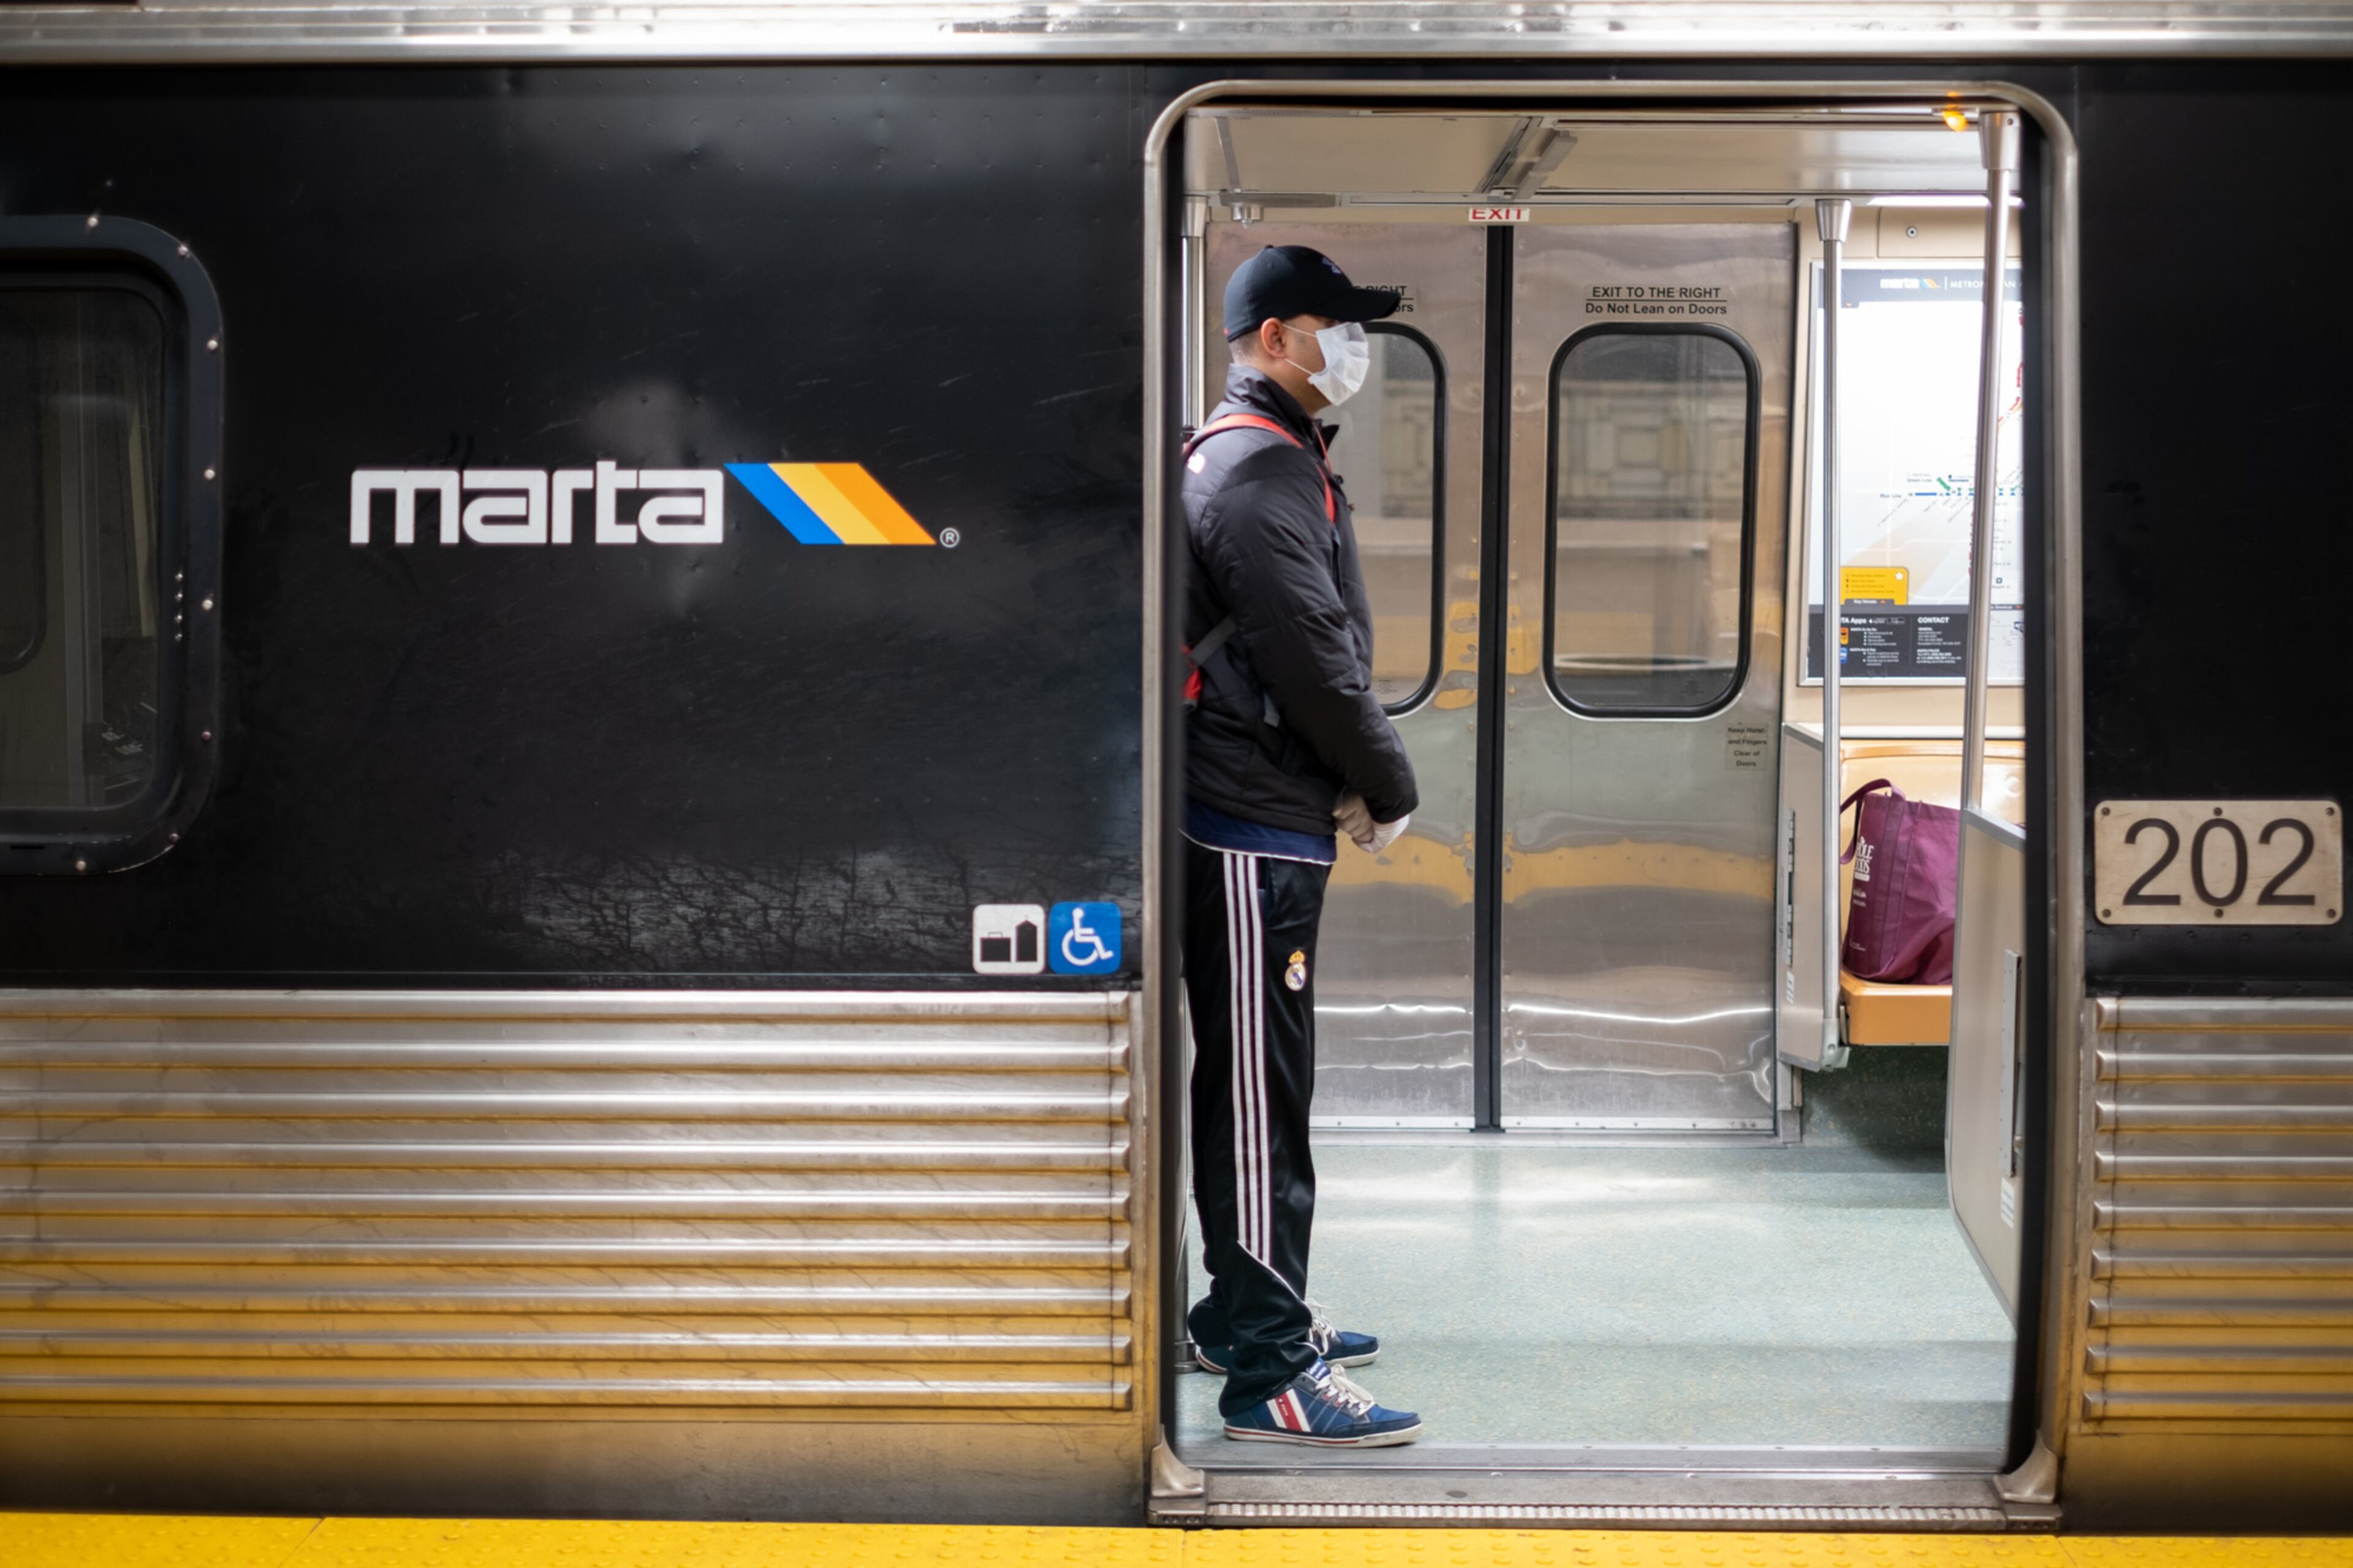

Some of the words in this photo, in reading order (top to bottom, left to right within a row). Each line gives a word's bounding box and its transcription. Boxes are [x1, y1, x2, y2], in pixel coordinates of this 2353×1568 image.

[1472, 208, 1525, 220] EXIT
[1593, 287, 1622, 297] EXIT
[1626, 287, 1644, 298] TO
[1648, 287, 1675, 298] THE
[1679, 287, 1721, 298] RIGHT
[1586, 303, 1603, 314] Do
[1607, 303, 1629, 314] Not
[1634, 303, 1664, 314] Lean
[1689, 304, 1727, 314] Doors
[350, 461, 724, 544] marta
[2123, 817, 2315, 907] 202
